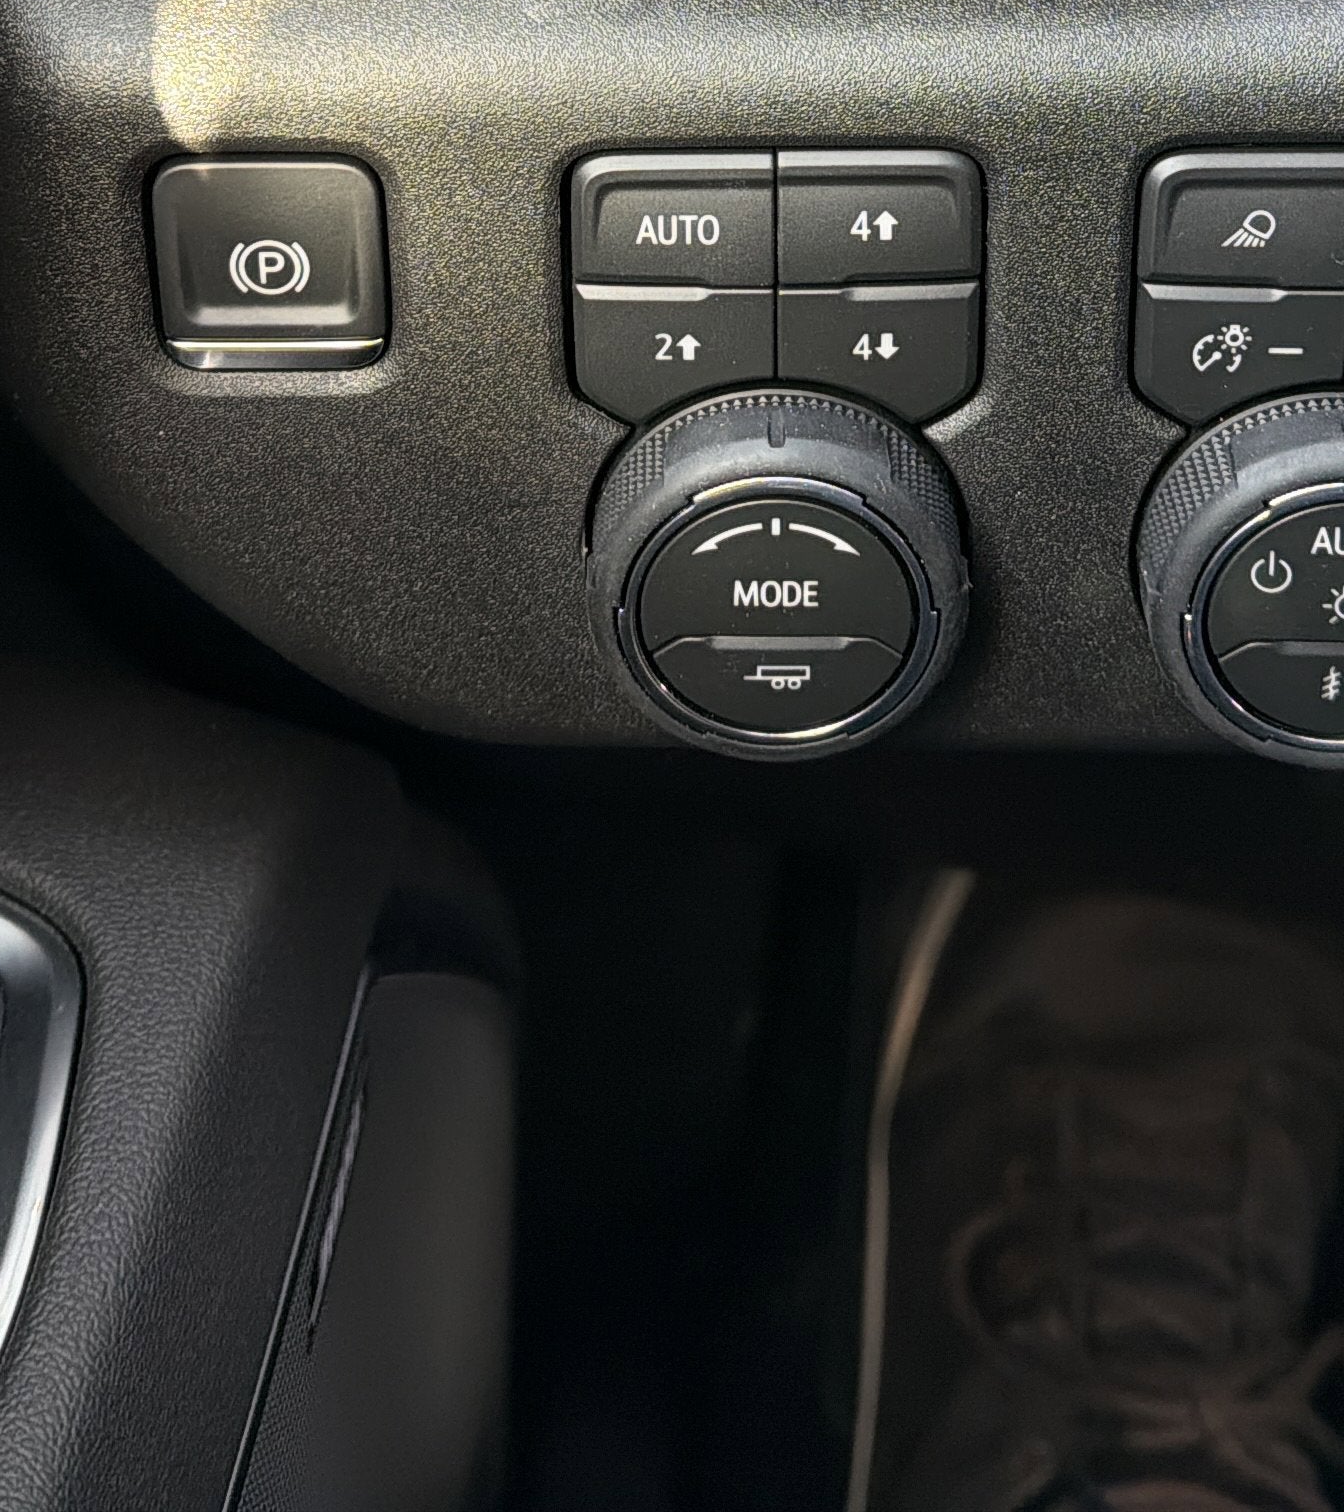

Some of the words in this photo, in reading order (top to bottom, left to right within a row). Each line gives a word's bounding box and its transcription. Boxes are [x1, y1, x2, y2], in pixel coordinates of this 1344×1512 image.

[635, 214, 720, 246] AUTO
[850, 211, 872, 242] 4
[258, 251, 286, 285] P
[654, 332, 674, 361] 2
[852, 333, 874, 361] 4
[733, 579, 819, 608] MODE
